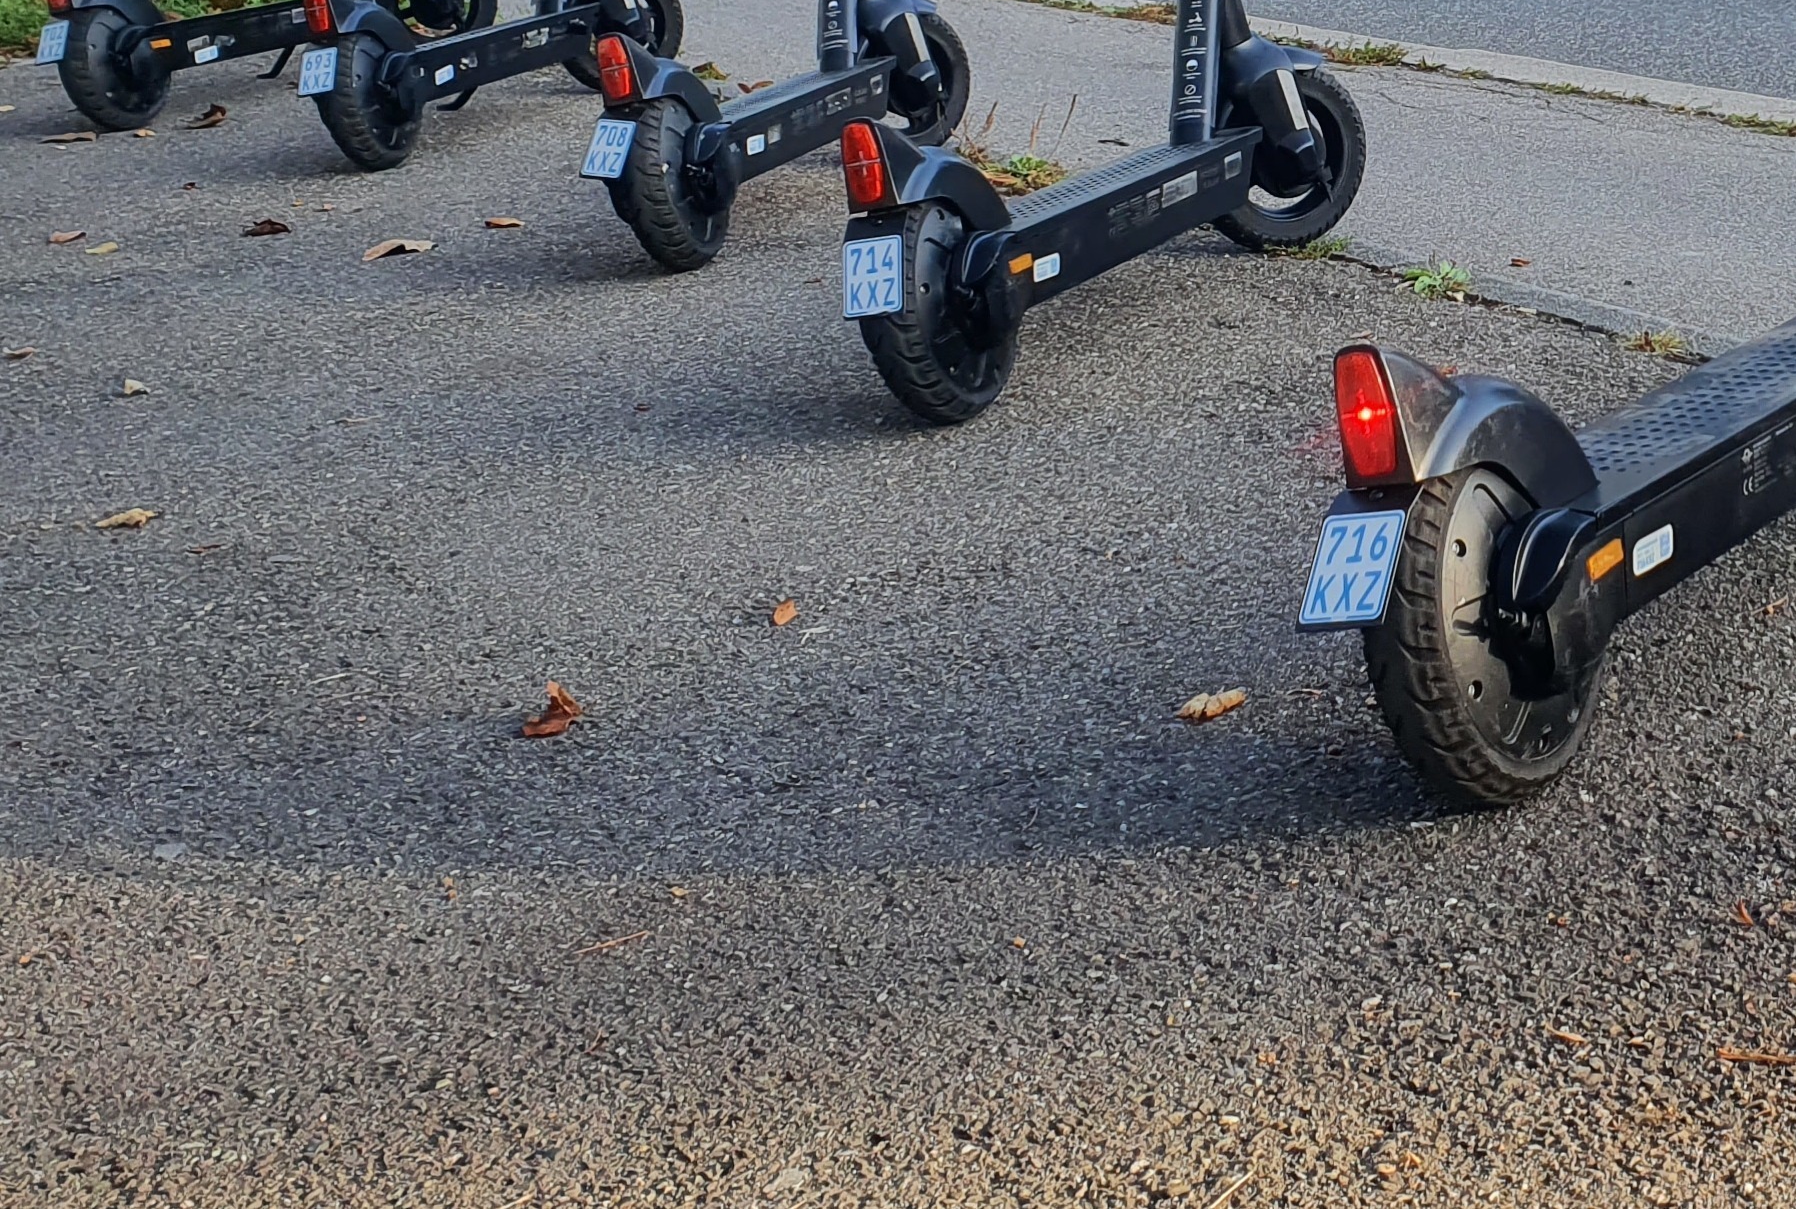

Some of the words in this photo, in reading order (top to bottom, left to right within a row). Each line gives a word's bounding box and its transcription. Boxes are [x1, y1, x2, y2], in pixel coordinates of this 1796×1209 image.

[305, 52, 333, 71] 693
[302, 71, 331, 91] KXZ
[596, 125, 629, 147] 708
[586, 150, 622, 173] KXZ
[850, 243, 894, 276] 714
[850, 277, 896, 311] KXZ
[1326, 522, 1389, 566] 716
[1310, 570, 1382, 615] KXZ
